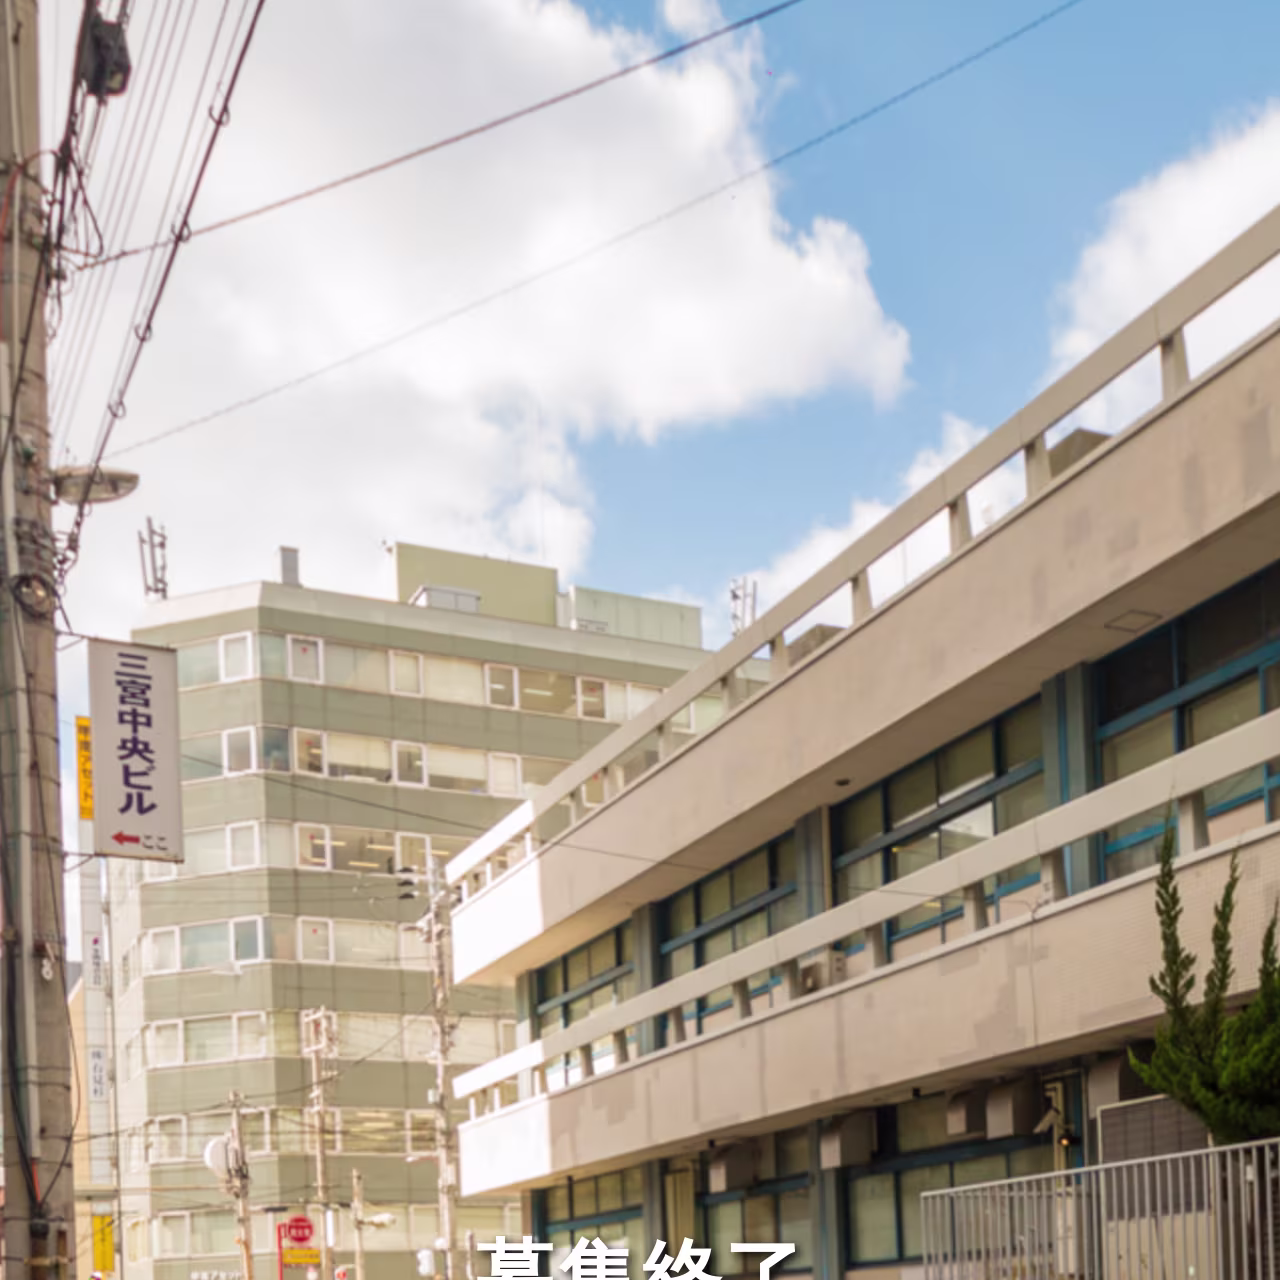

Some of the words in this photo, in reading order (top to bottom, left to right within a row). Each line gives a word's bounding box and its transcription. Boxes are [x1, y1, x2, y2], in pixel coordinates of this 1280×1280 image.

[114, 650, 158, 817] 三宮中央ビル
[142, 834, 168, 851] ここ
